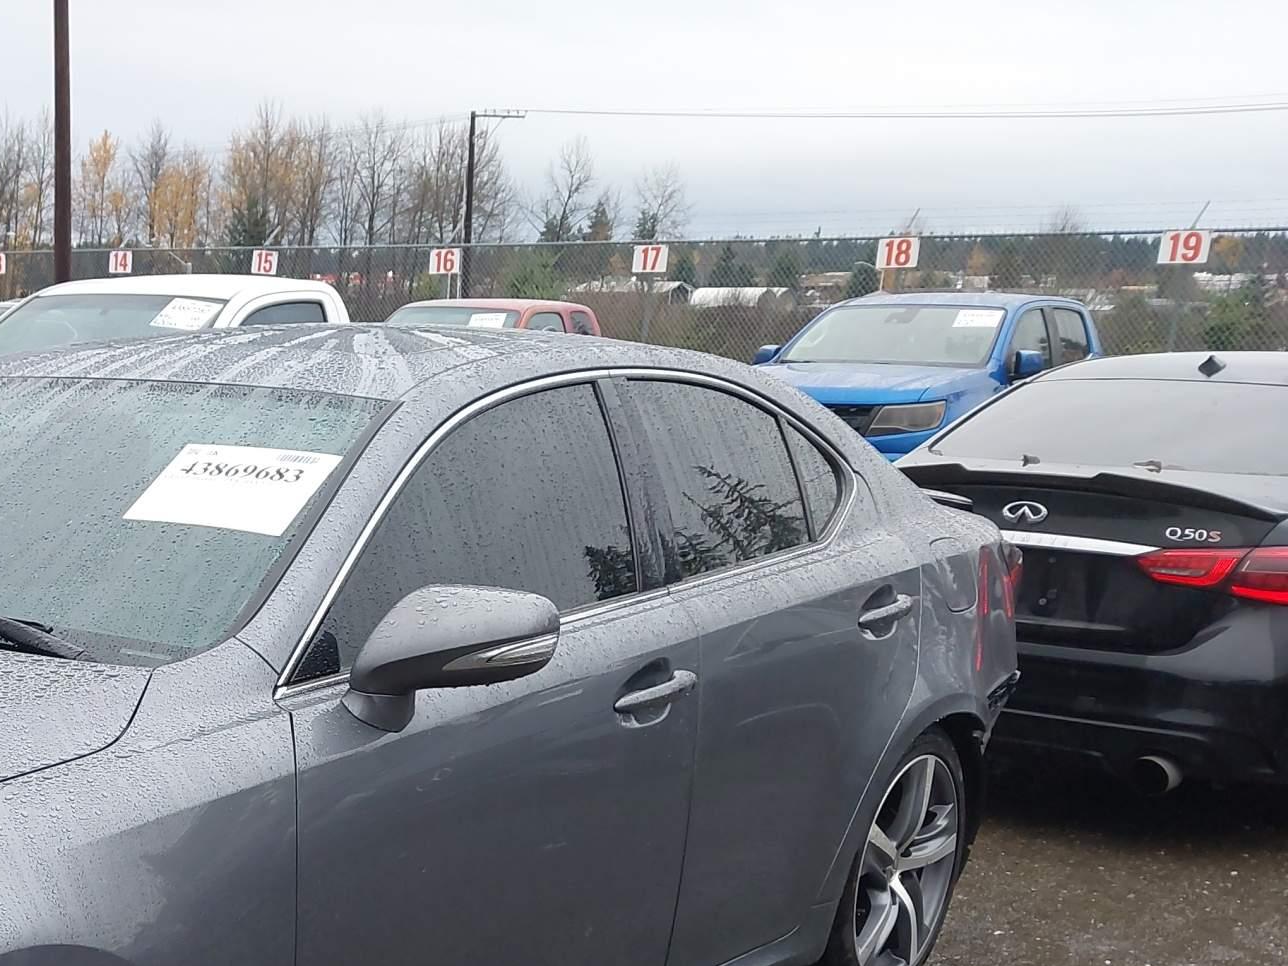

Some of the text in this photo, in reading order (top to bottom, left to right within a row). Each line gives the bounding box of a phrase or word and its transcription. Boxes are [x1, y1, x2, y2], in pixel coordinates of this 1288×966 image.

[884, 239, 912, 266] 18
[1169, 231, 1203, 262] 19
[113, 252, 128, 272] 14
[256, 252, 273, 273] 15
[435, 250, 455, 272] 16
[641, 246, 663, 271] 17
[180, 460, 305, 483] 43869683
[1165, 526, 1222, 543] Q50S
